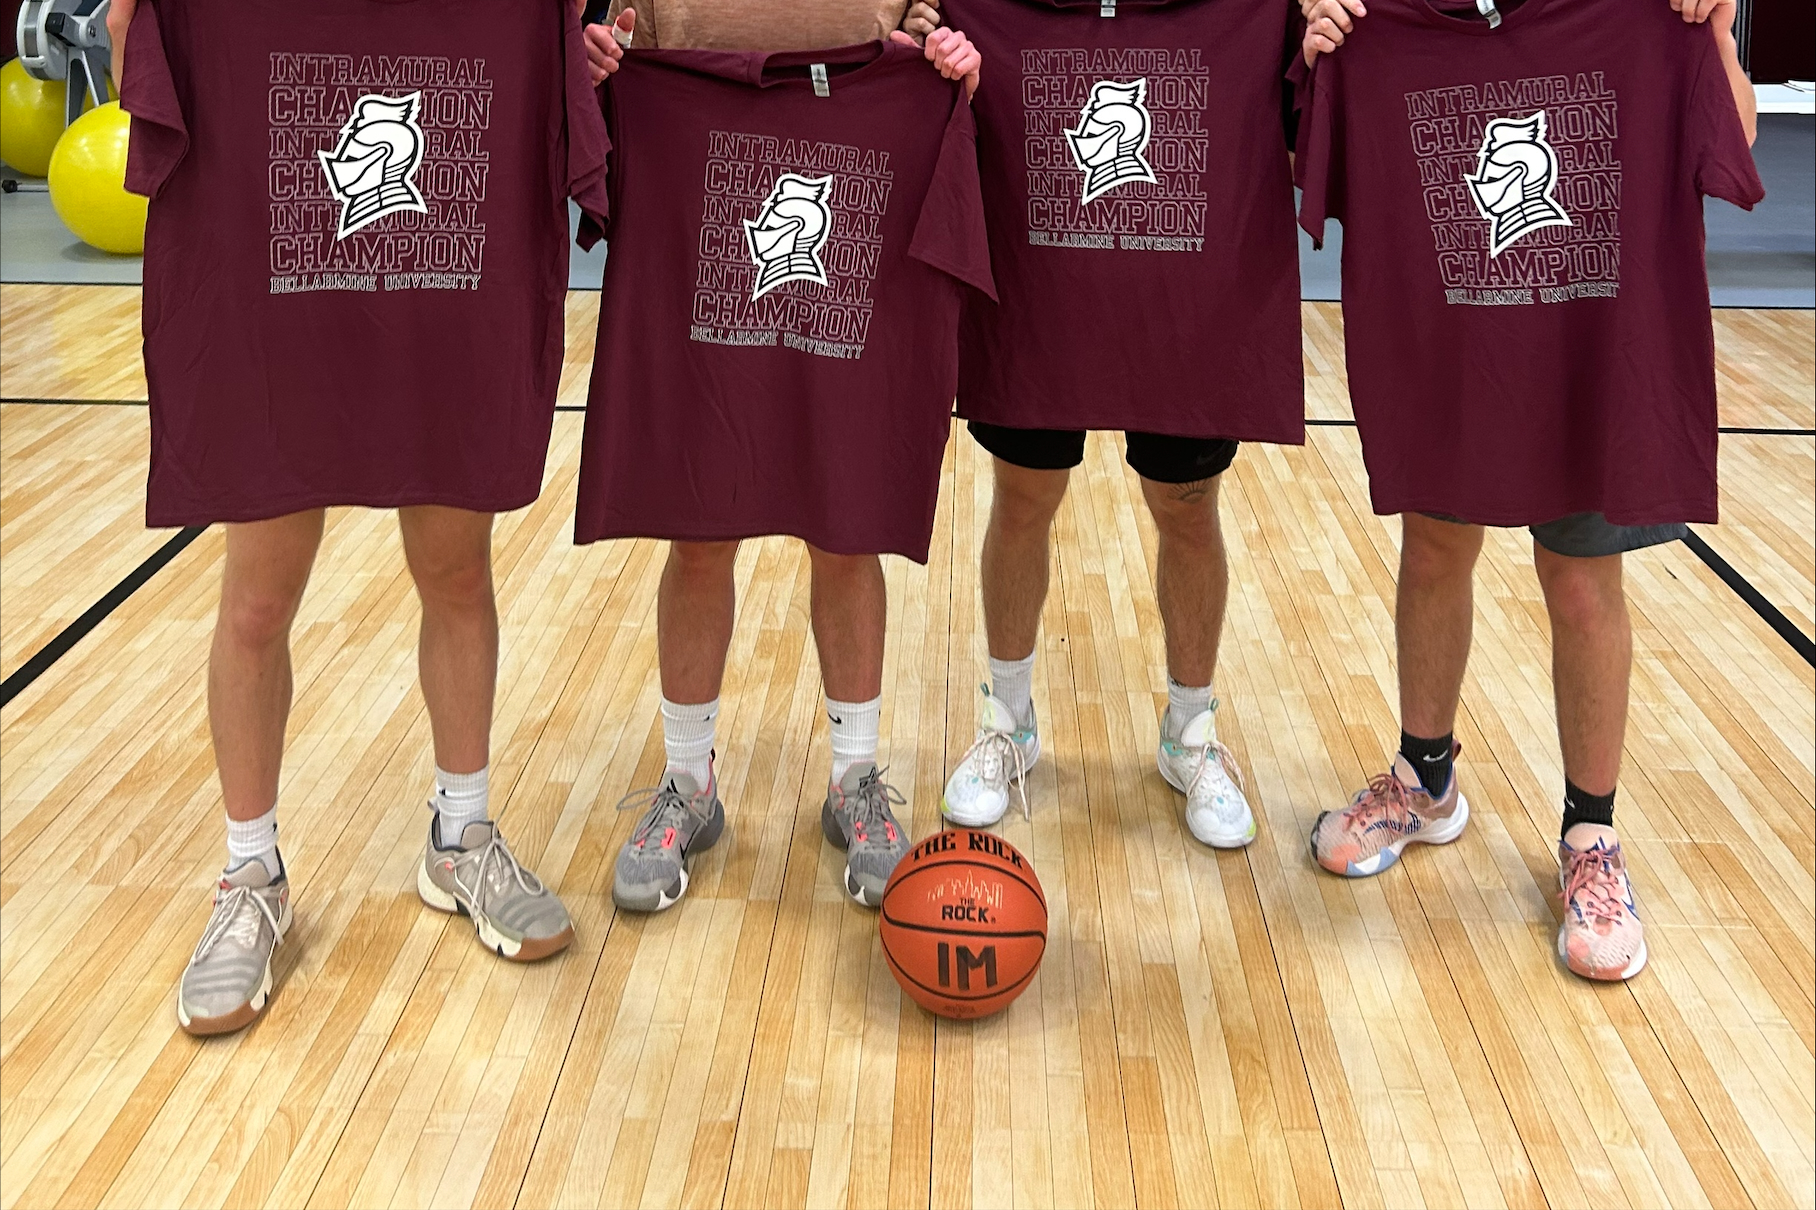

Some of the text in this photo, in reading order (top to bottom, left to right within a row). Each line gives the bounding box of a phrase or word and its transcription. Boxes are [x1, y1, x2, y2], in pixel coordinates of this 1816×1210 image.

[269, 52, 493, 89] INTRAMURAL
[1021, 48, 1209, 75] INTRAMURAL
[268, 86, 493, 129] CHAION
[1022, 75, 1209, 110] CHAION
[1404, 70, 1616, 120] INTRAMURAL
[1024, 110, 1209, 137] INTRAL
[1410, 100, 1618, 157] CHAION
[269, 128, 490, 161] INTRAL
[708, 130, 894, 180] INTRAMURAL
[1025, 136, 1208, 173] CHION
[1417, 141, 1622, 187] INTRAL
[268, 161, 489, 201] CHION
[704, 158, 893, 216] CHAION
[1423, 172, 1622, 222] CHION
[702, 195, 884, 244] INTRAL
[1027, 196, 1207, 236] CHAMPION
[270, 233, 486, 274] CHAMPION
[699, 223, 882, 280] CHION
[1028, 230, 1205, 252] BELLARMINE UNIVERSITY
[269, 272, 481, 294] BELLARMINE UNIVERSITY
[1437, 242, 1620, 289] CHAMPION
[1445, 281, 1620, 306] BELLARMINE UNIVERSIT
[692, 289, 873, 344] CHAMPION
[690, 324, 865, 360] BELLARMINE UNIVERSITY
[911, 832, 1023, 869] THE ROCK
[942, 904, 989, 924] ROCK
[960, 897, 975, 907] THE
[937, 941, 998, 991] IM
